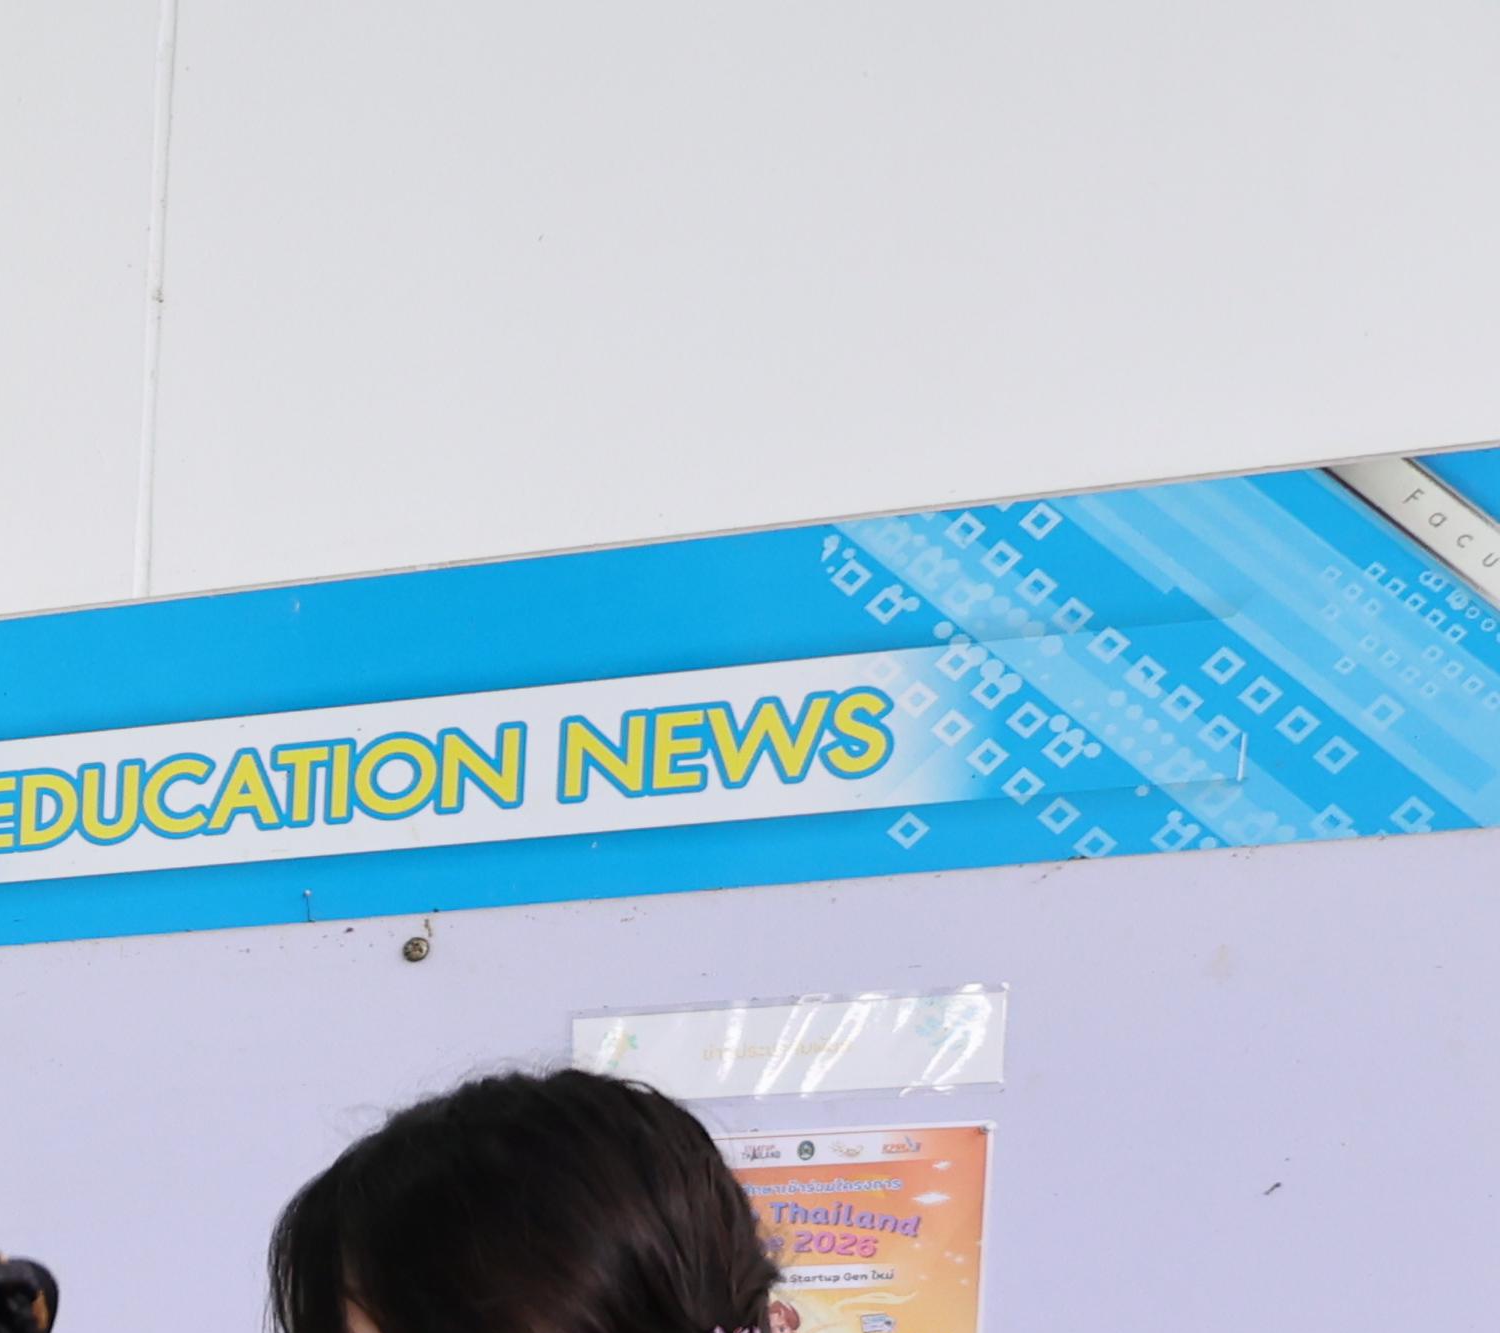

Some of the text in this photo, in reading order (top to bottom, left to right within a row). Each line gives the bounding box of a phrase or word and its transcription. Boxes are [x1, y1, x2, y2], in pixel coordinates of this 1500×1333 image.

[560, 689, 893, 802] NEWS
[769, 1201, 921, 1238] Thailand
[794, 1230, 879, 1258] 2026
[790, 1273, 840, 1284] Startup
[843, 1271, 868, 1282] Gen
